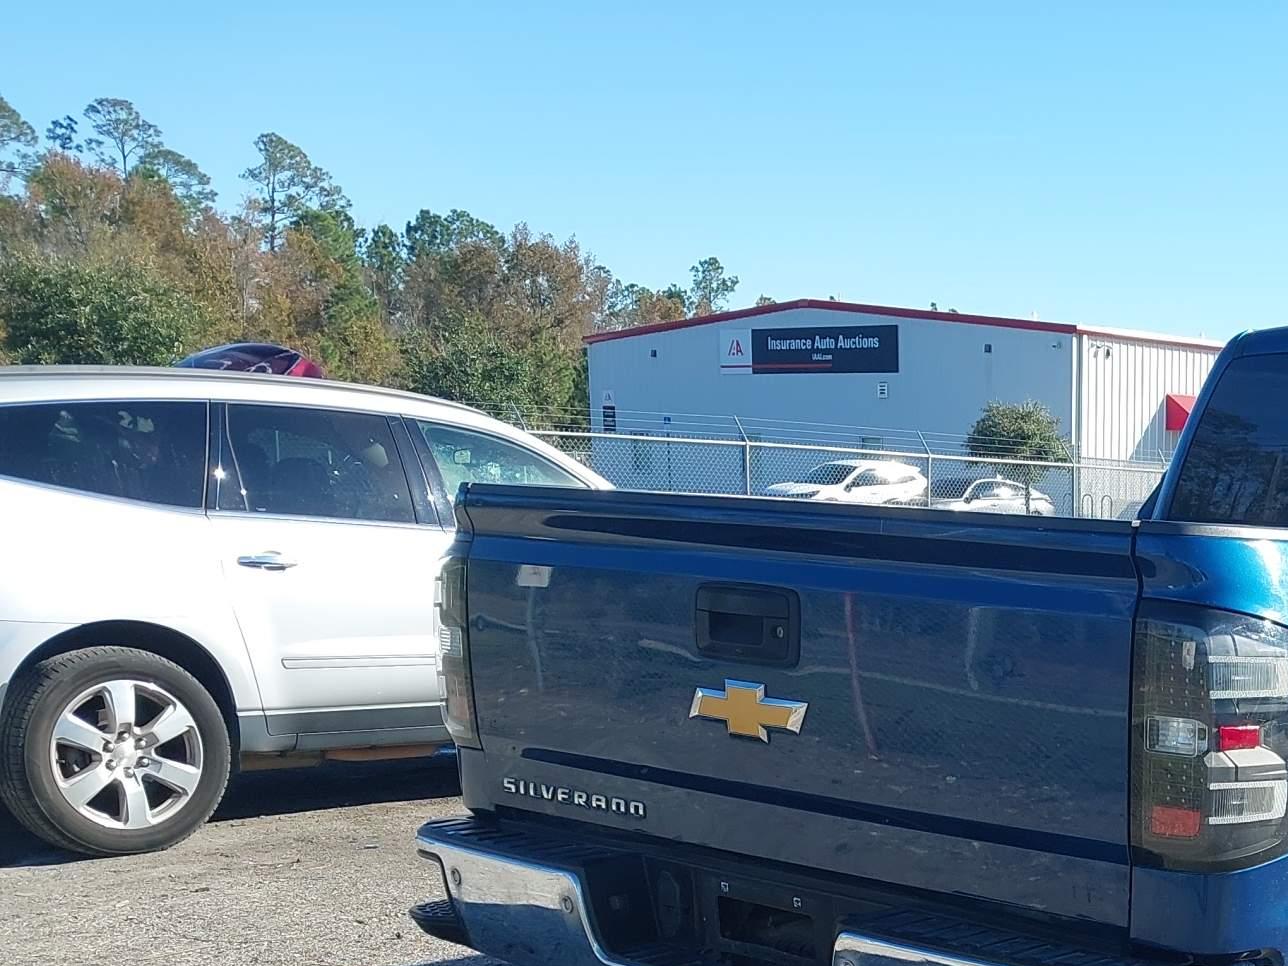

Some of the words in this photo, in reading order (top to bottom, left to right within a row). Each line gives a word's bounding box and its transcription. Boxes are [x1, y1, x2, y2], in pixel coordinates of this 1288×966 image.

[767, 335, 812, 351] Insurance
[814, 335, 835, 349] Auto
[837, 333, 880, 349] Auctions
[503, 777, 646, 817] SILVERADO
